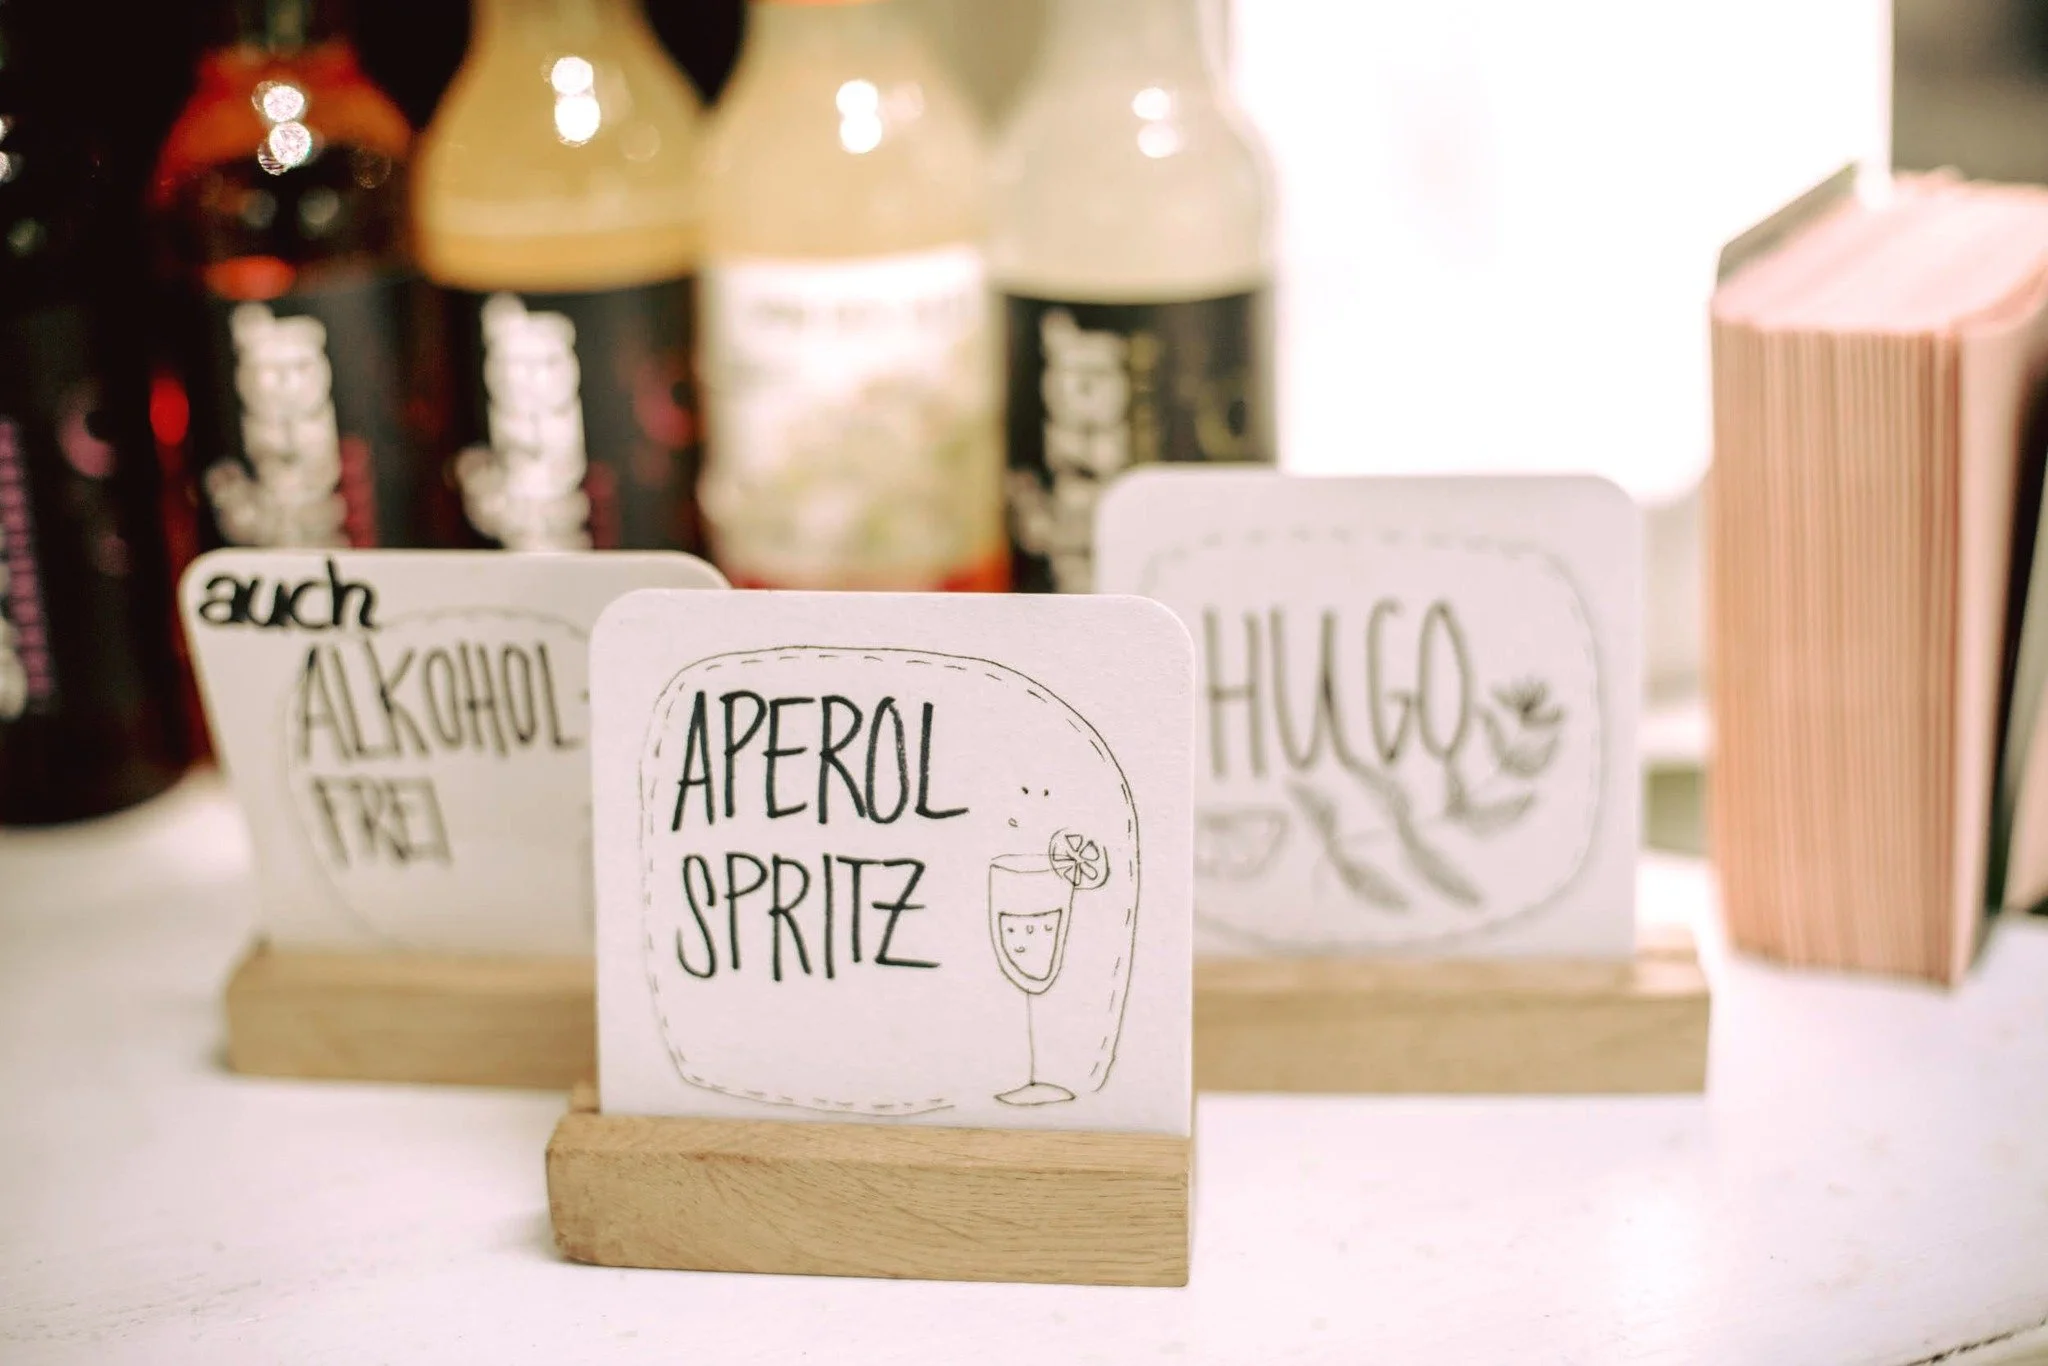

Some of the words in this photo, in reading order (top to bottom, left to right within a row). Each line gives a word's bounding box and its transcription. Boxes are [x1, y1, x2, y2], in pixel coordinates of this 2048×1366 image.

[199, 557, 379, 632] auch
[1203, 597, 1474, 780] HUGO
[671, 690, 970, 831] APEROL
[676, 853, 942, 982] SPRITZ
